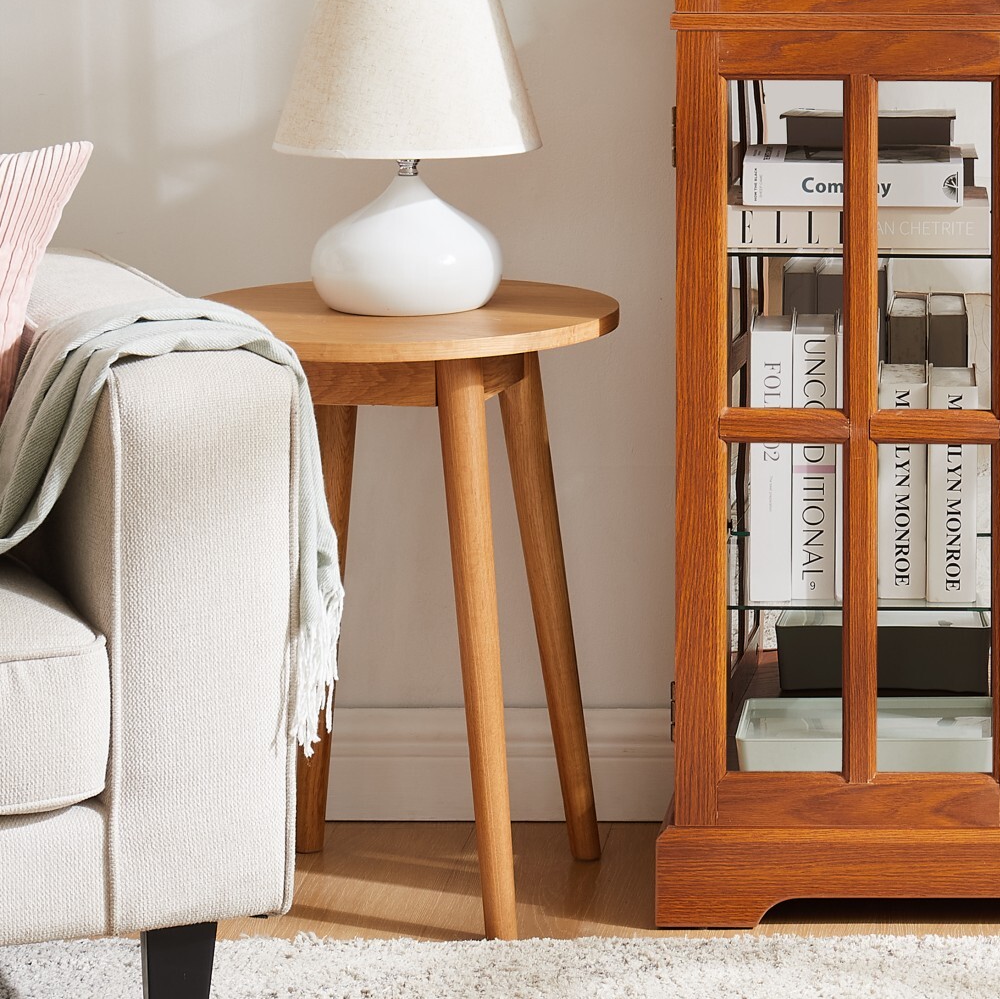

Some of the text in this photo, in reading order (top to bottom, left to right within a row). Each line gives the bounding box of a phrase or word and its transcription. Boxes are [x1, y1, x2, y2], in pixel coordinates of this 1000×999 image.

[741, 211, 844, 244] ELL
[894, 494, 911, 586] MONROE
[945, 499, 962, 592] MONROE
